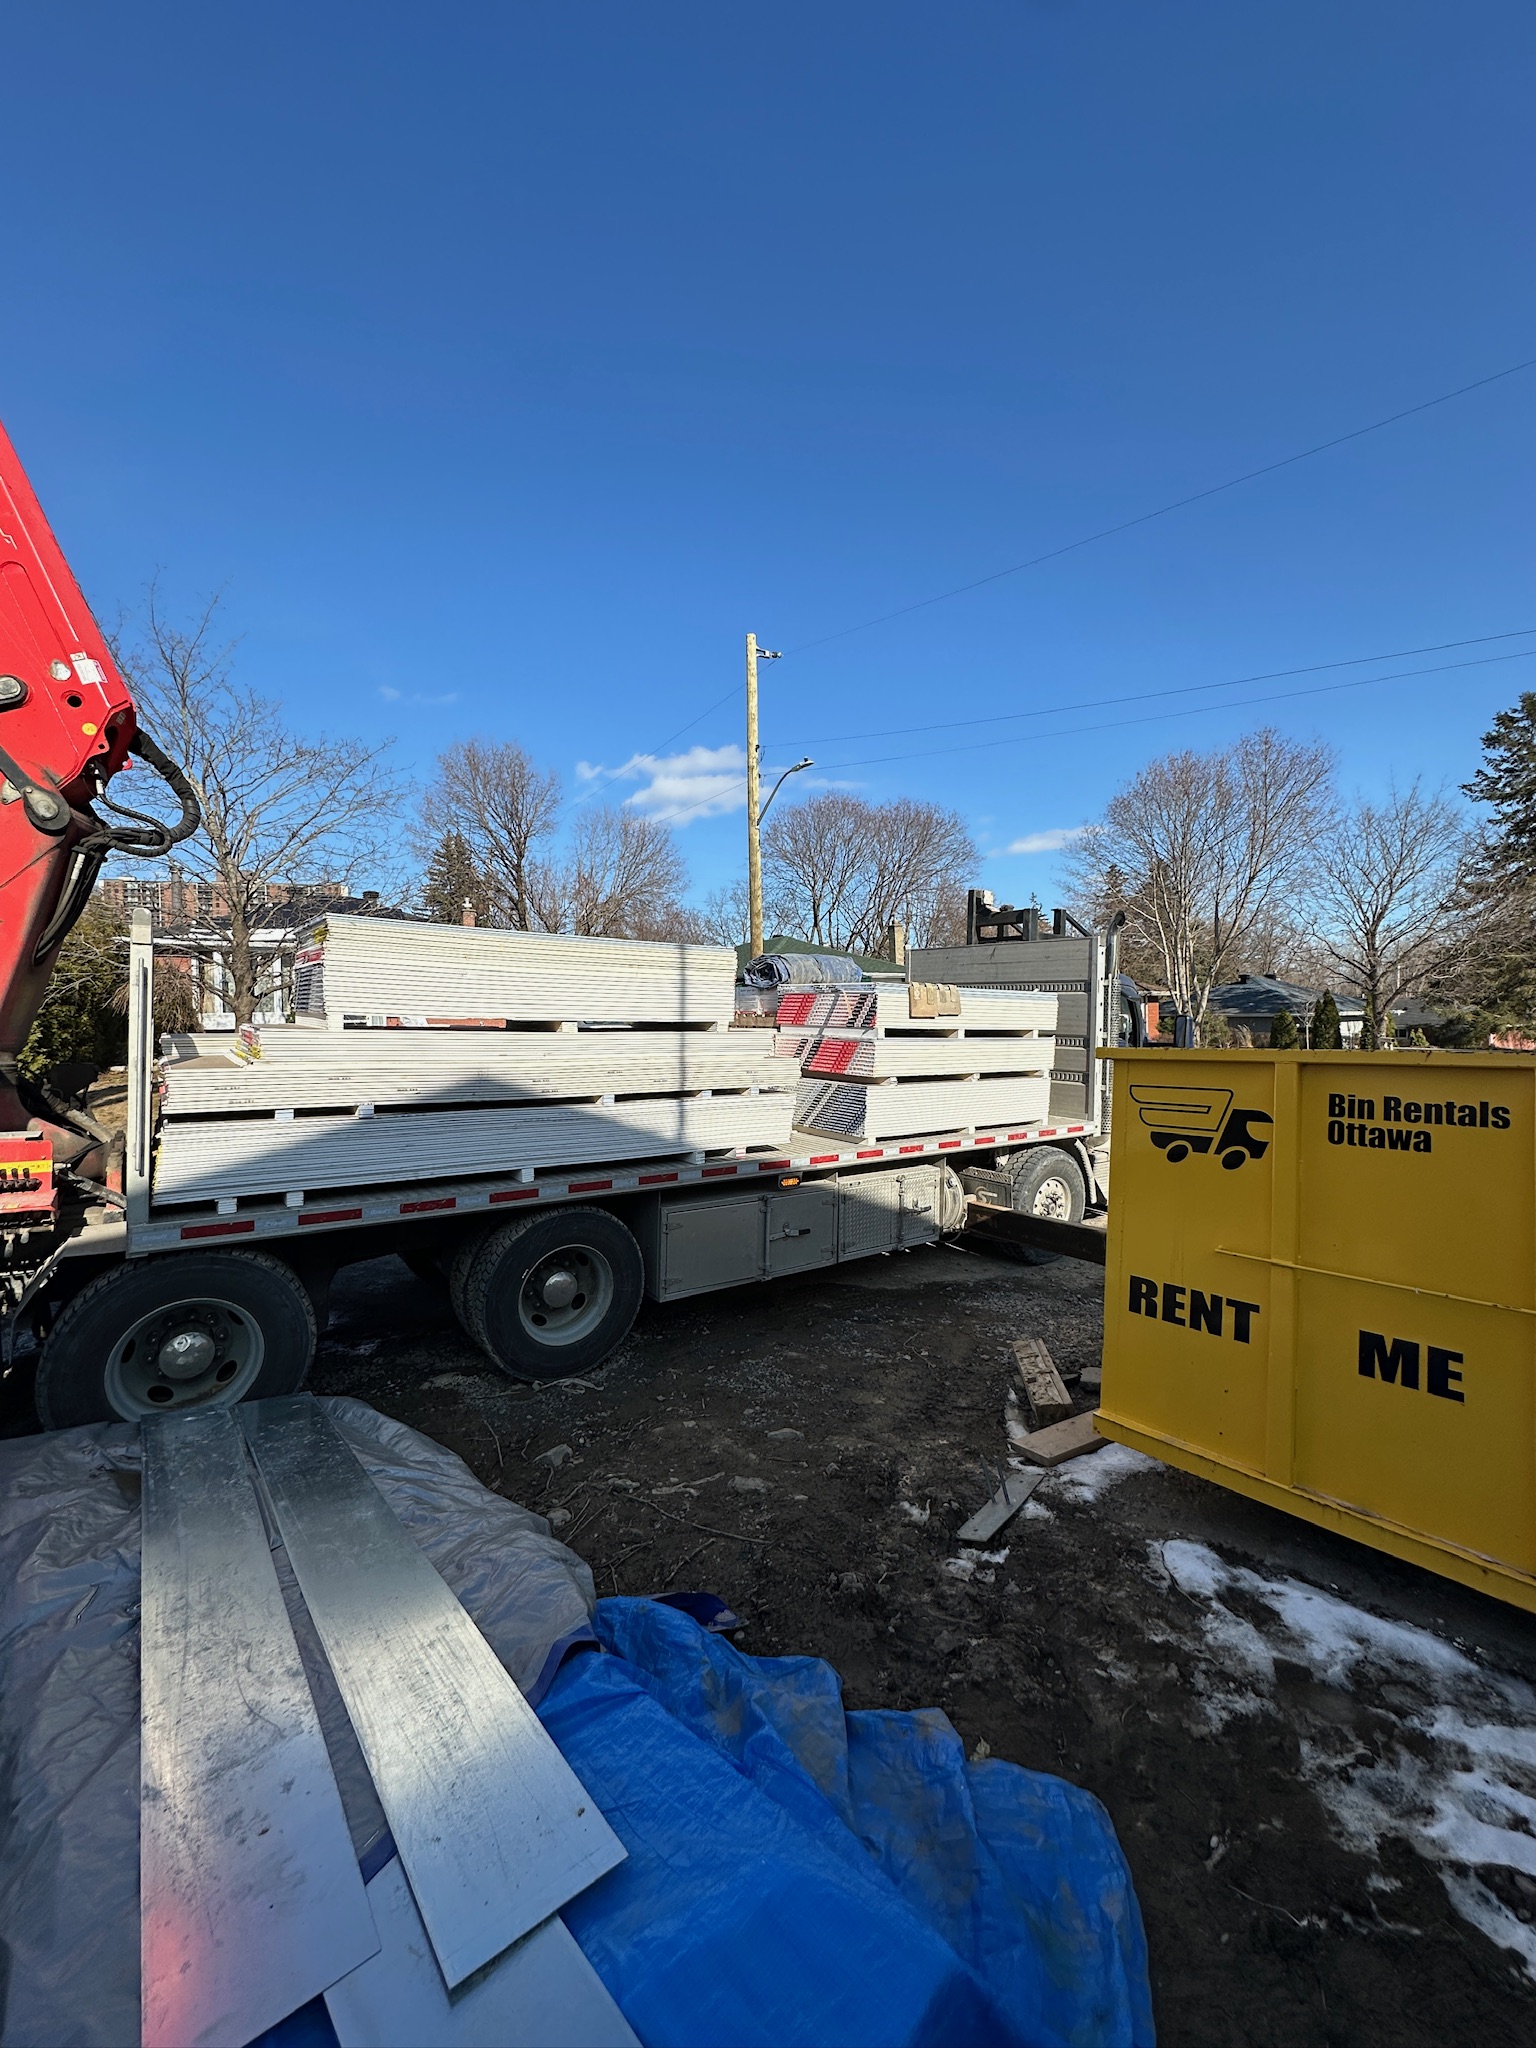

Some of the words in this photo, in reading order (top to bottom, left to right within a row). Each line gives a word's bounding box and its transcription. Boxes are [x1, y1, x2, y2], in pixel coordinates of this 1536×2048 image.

[1327, 1119, 1432, 1154] Ottawa
[1328, 1093, 1375, 1121] Bin
[1383, 1095, 1511, 1130] Rentals
[1128, 1274, 1261, 1345] RENT
[1358, 1329, 1465, 1405] ME
